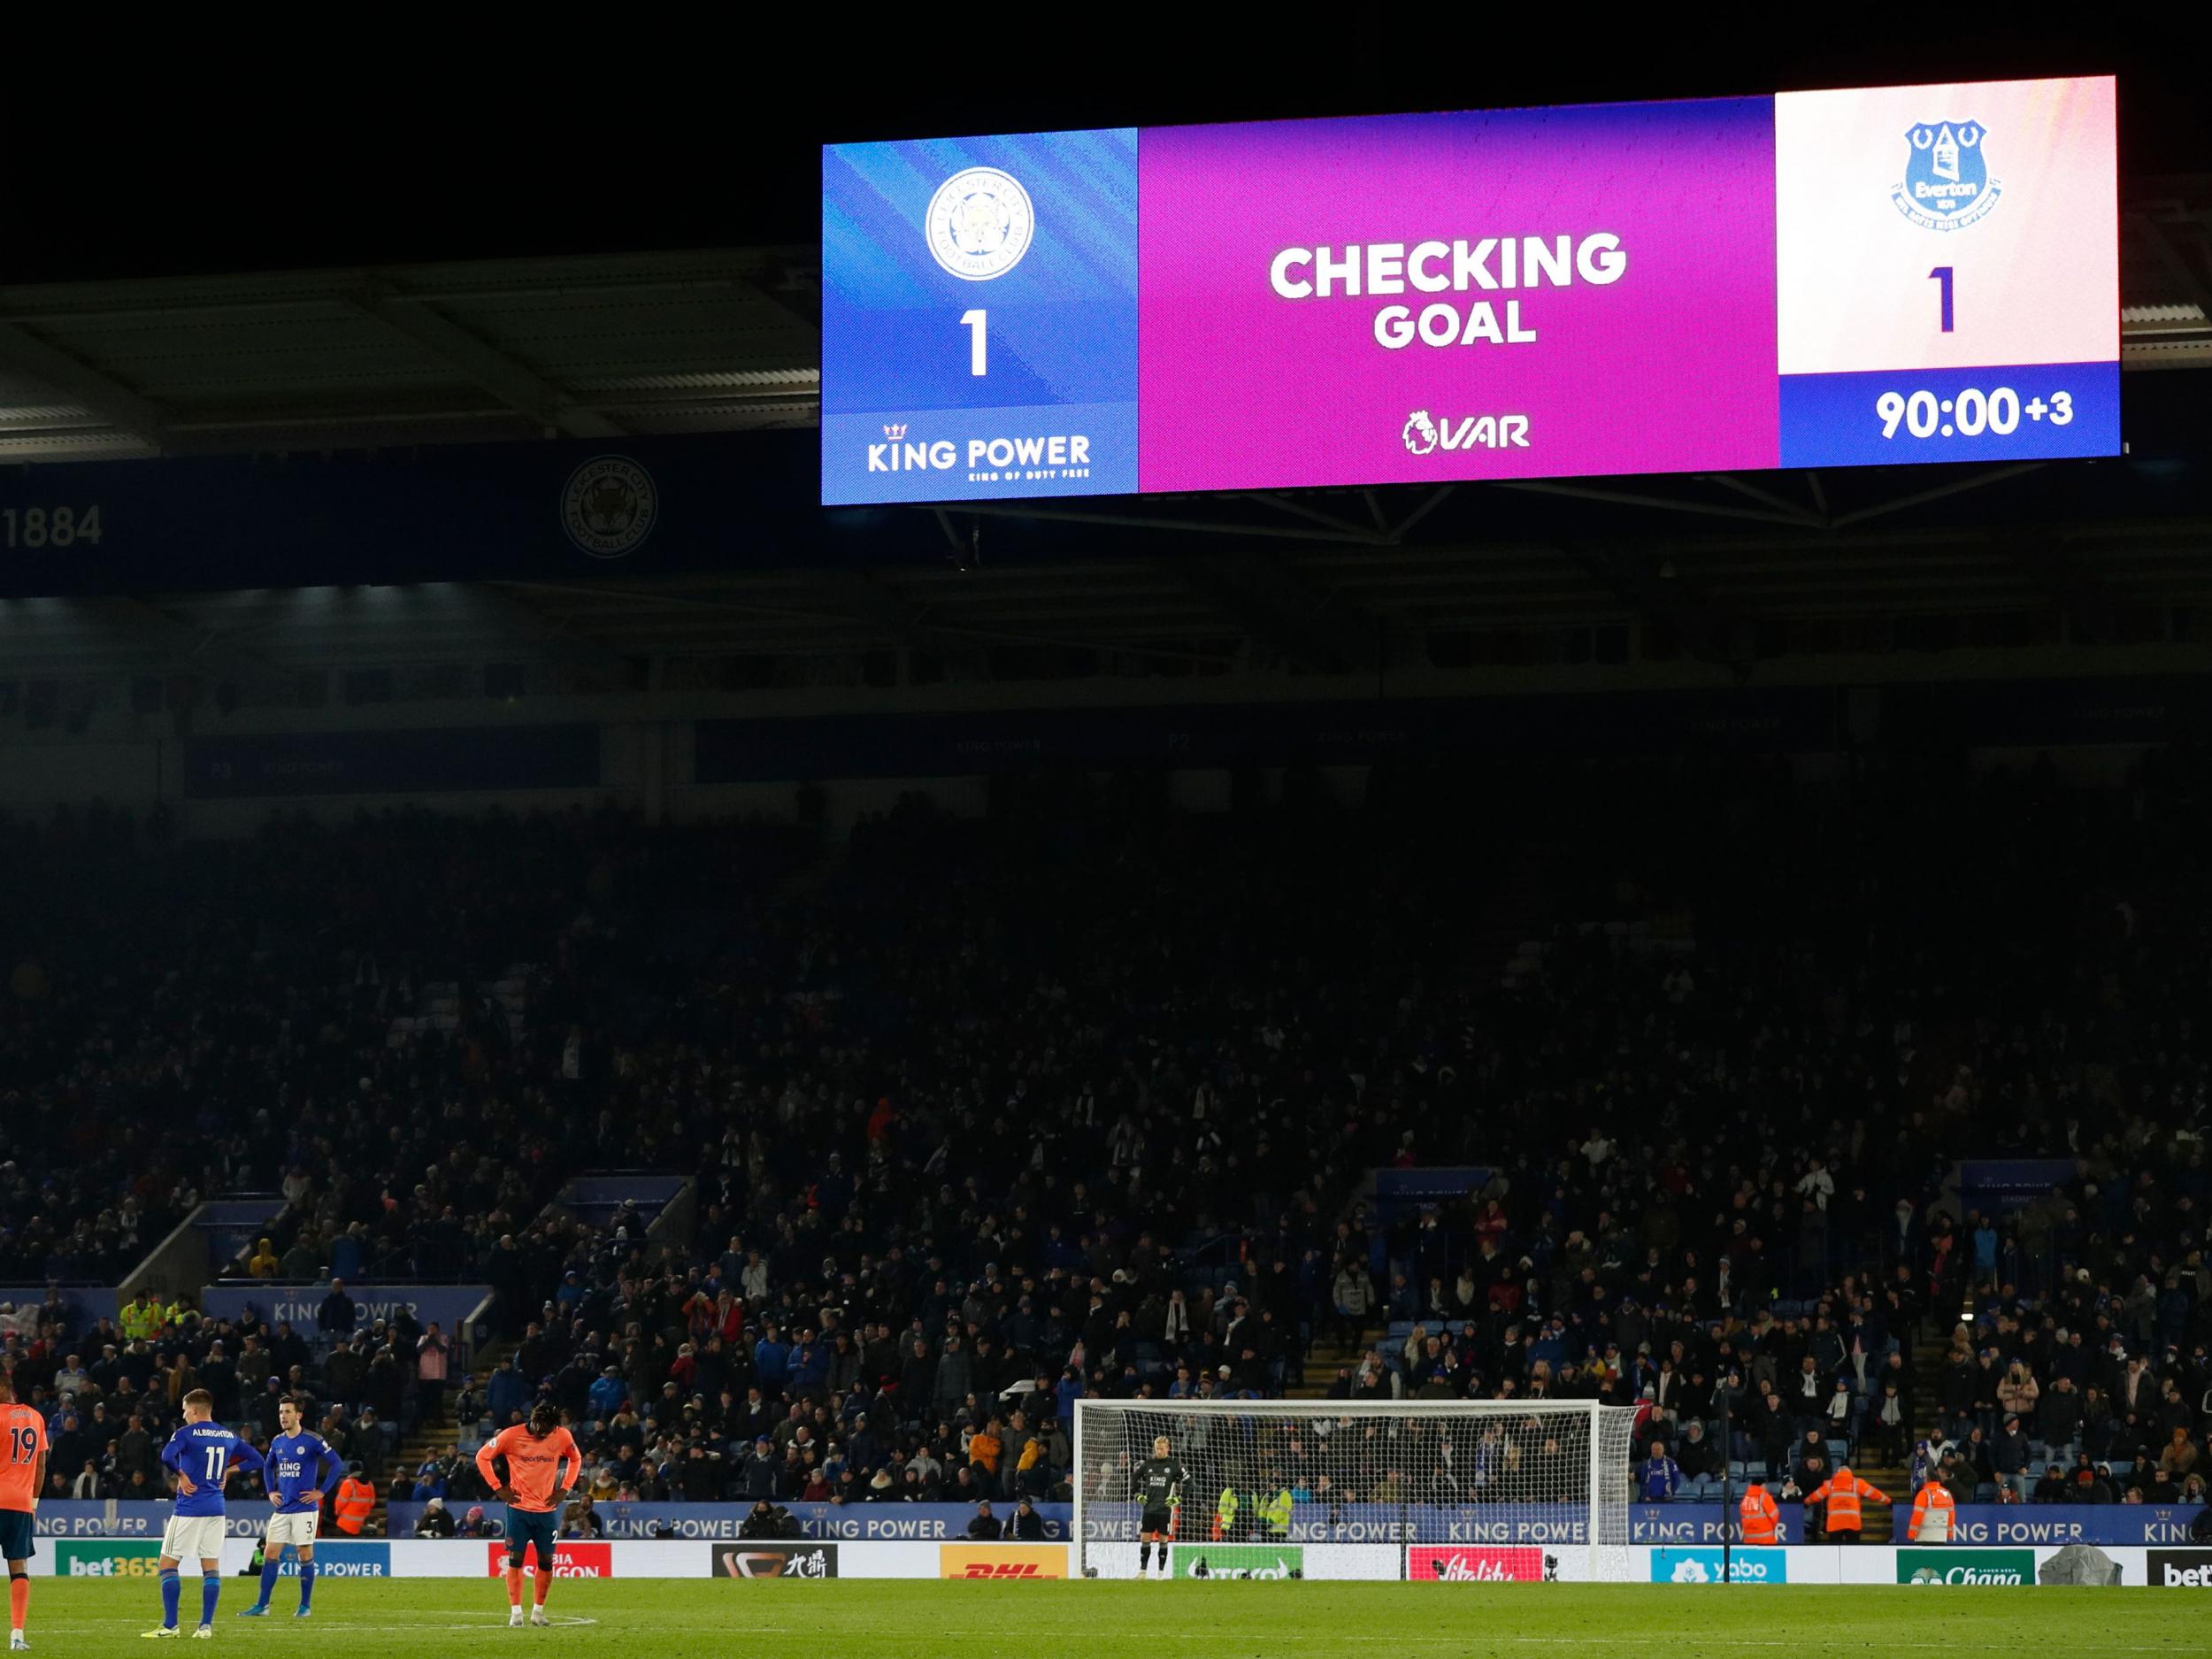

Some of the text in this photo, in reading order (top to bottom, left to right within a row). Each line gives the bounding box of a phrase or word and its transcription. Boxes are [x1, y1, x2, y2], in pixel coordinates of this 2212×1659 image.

[1915, 181, 1977, 197] Everton
[1271, 233, 1626, 298] CHECKING
[1928, 266, 1954, 333] 1
[1374, 300, 1537, 349] GOAL
[960, 309, 987, 376] 1
[1440, 415, 1530, 450] VAR
[868, 435, 1090, 472] KING POWER
[968, 468, 1090, 481] KING OF DUTY FREE
[2, 504, 103, 548] 1884
[354, 1302, 418, 1320] OWER
[193, 1429, 234, 1439] ALBRIGHTON
[10, 1426, 38, 1463] 19
[205, 1446, 225, 1479] 11
[36, 1517, 67, 1534] NG
[226, 1519, 269, 1535] POW
[306, 1521, 313, 1534] 3
[803, 1520, 946, 1538] KING POWER
[1291, 1522, 1417, 1540] NG POWER
[1448, 1522, 1590, 1540] KING POWE
[1634, 1522, 1787, 1541] KING POR
[1952, 1523, 2082, 1542] NG POWER
[69, 1555, 159, 1576] bet365
[325, 1563, 382, 1577] POWER
[523, 1565, 600, 1578] SIGON
[965, 1563, 1040, 1579] DHL
[1713, 1557, 1767, 1579] yabo
[2163, 1563, 2212, 1586] bet
